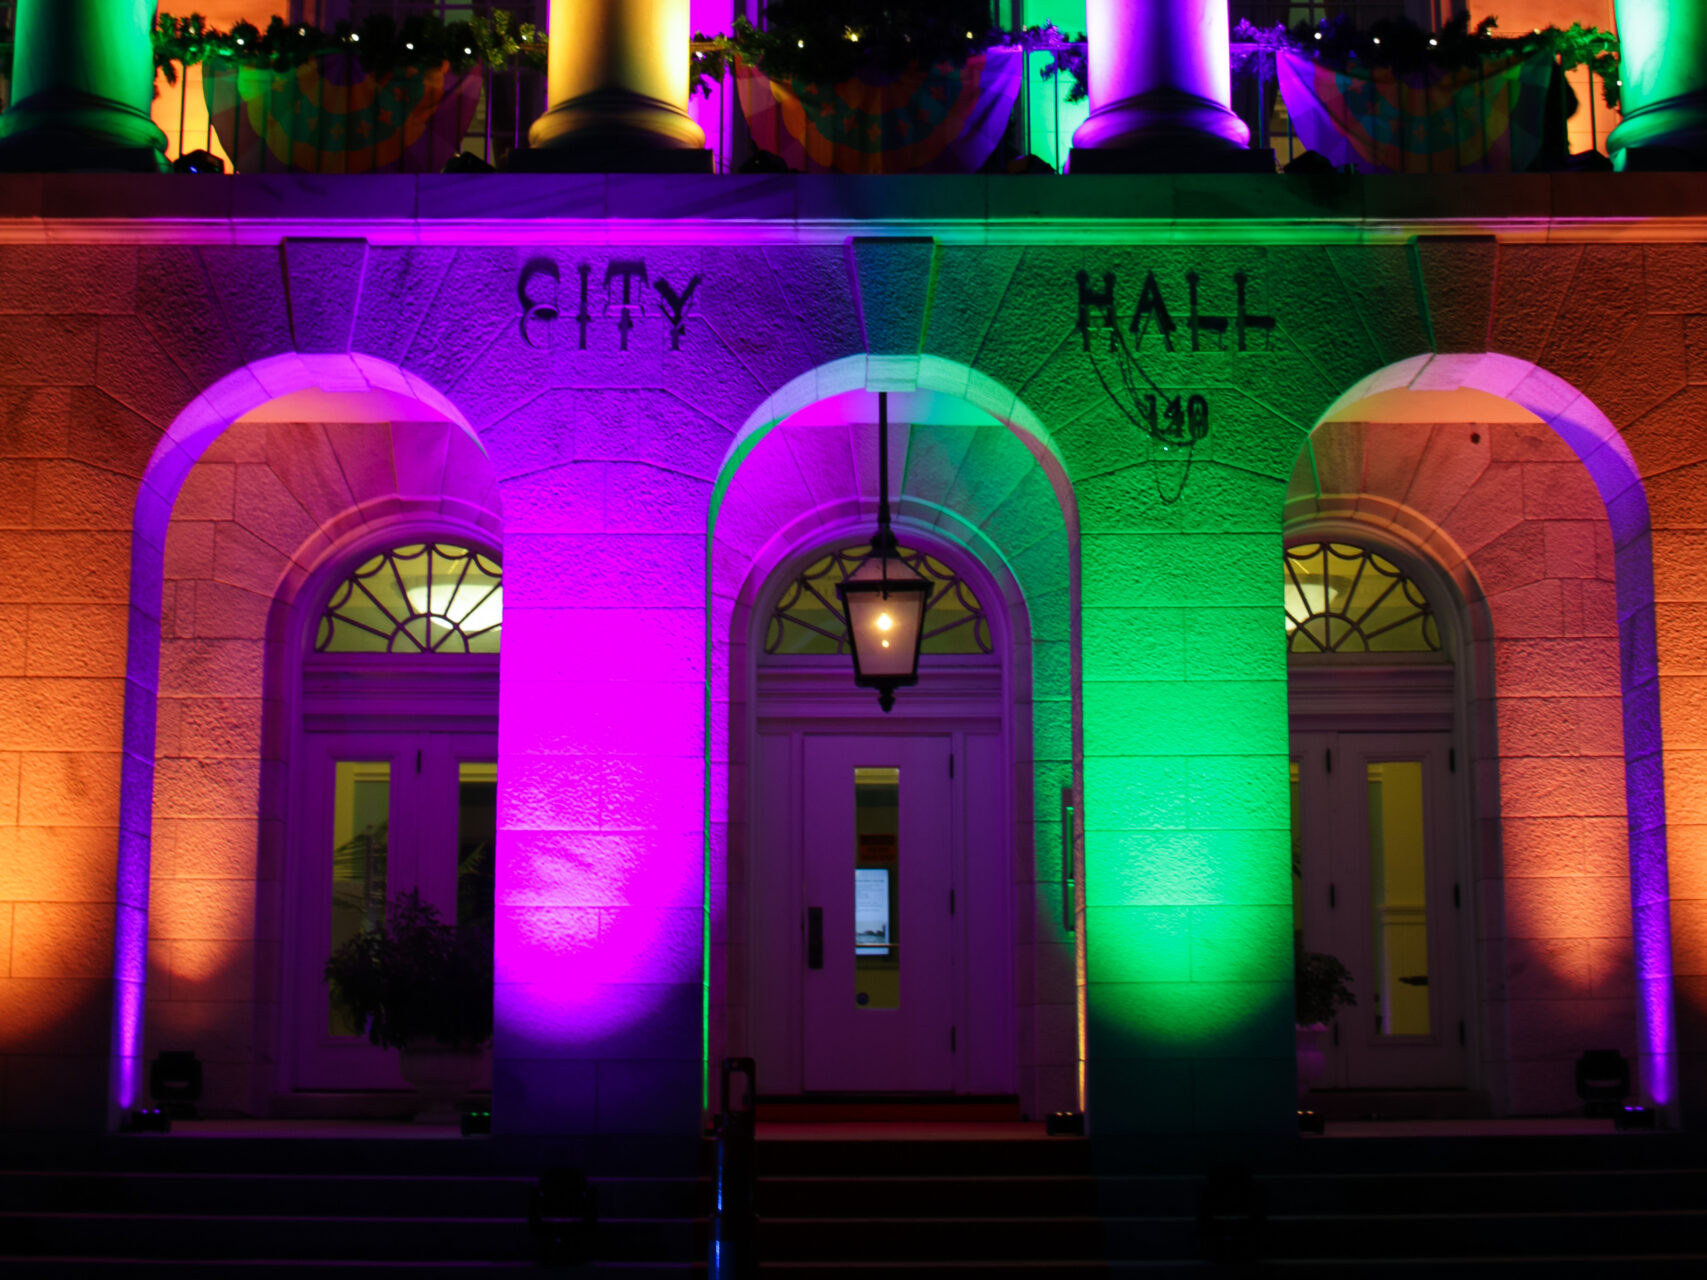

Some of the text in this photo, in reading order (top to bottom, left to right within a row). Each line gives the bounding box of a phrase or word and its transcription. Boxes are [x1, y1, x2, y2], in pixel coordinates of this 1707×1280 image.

[517, 260, 1275, 352] CITY HALL
[1144, 394, 1209, 439] 140
